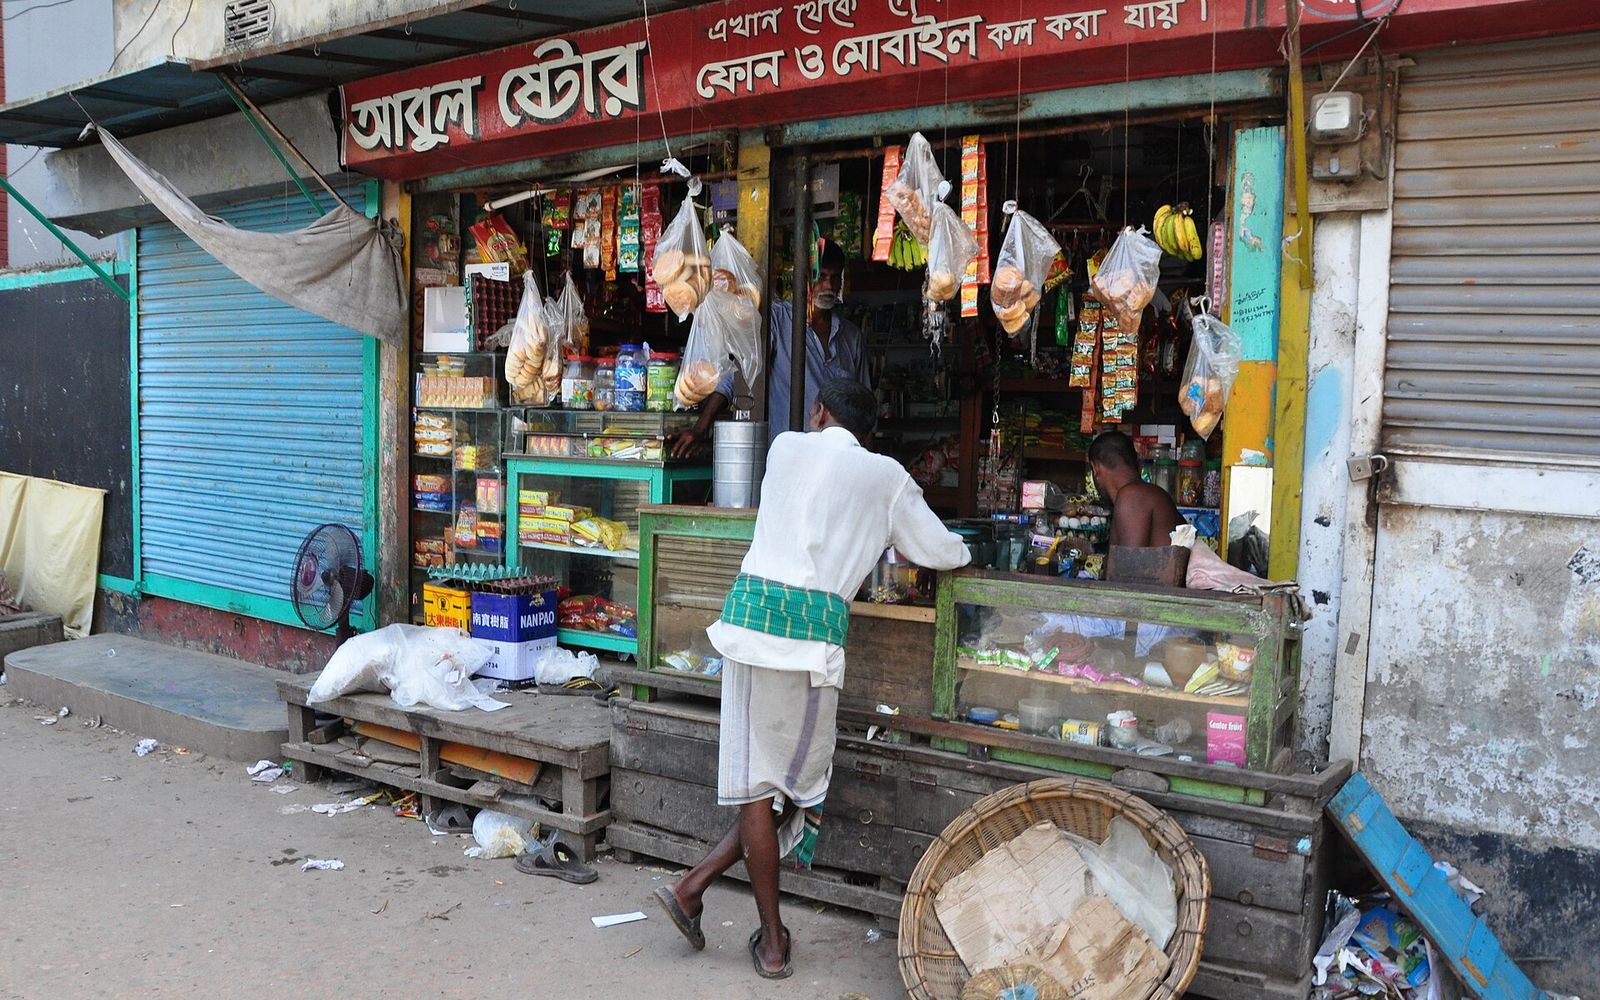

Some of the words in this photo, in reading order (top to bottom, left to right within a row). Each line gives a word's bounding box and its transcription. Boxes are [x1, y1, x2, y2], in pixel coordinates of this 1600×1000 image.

[708, 7, 783, 42] এখান
[696, 50, 785, 99] ফোন
[795, 44, 825, 80] ও
[833, 15, 983, 75] মোবাইল
[986, 18, 1037, 50] কল
[1043, 9, 1107, 40] করা
[1124, 0, 1185, 29] যায়
[349, 75, 482, 152] আবুল
[498, 38, 646, 128] ষ্টোর
[472, 612, 509, 629] 南寶樹脂
[520, 610, 555, 629] NANPAO
